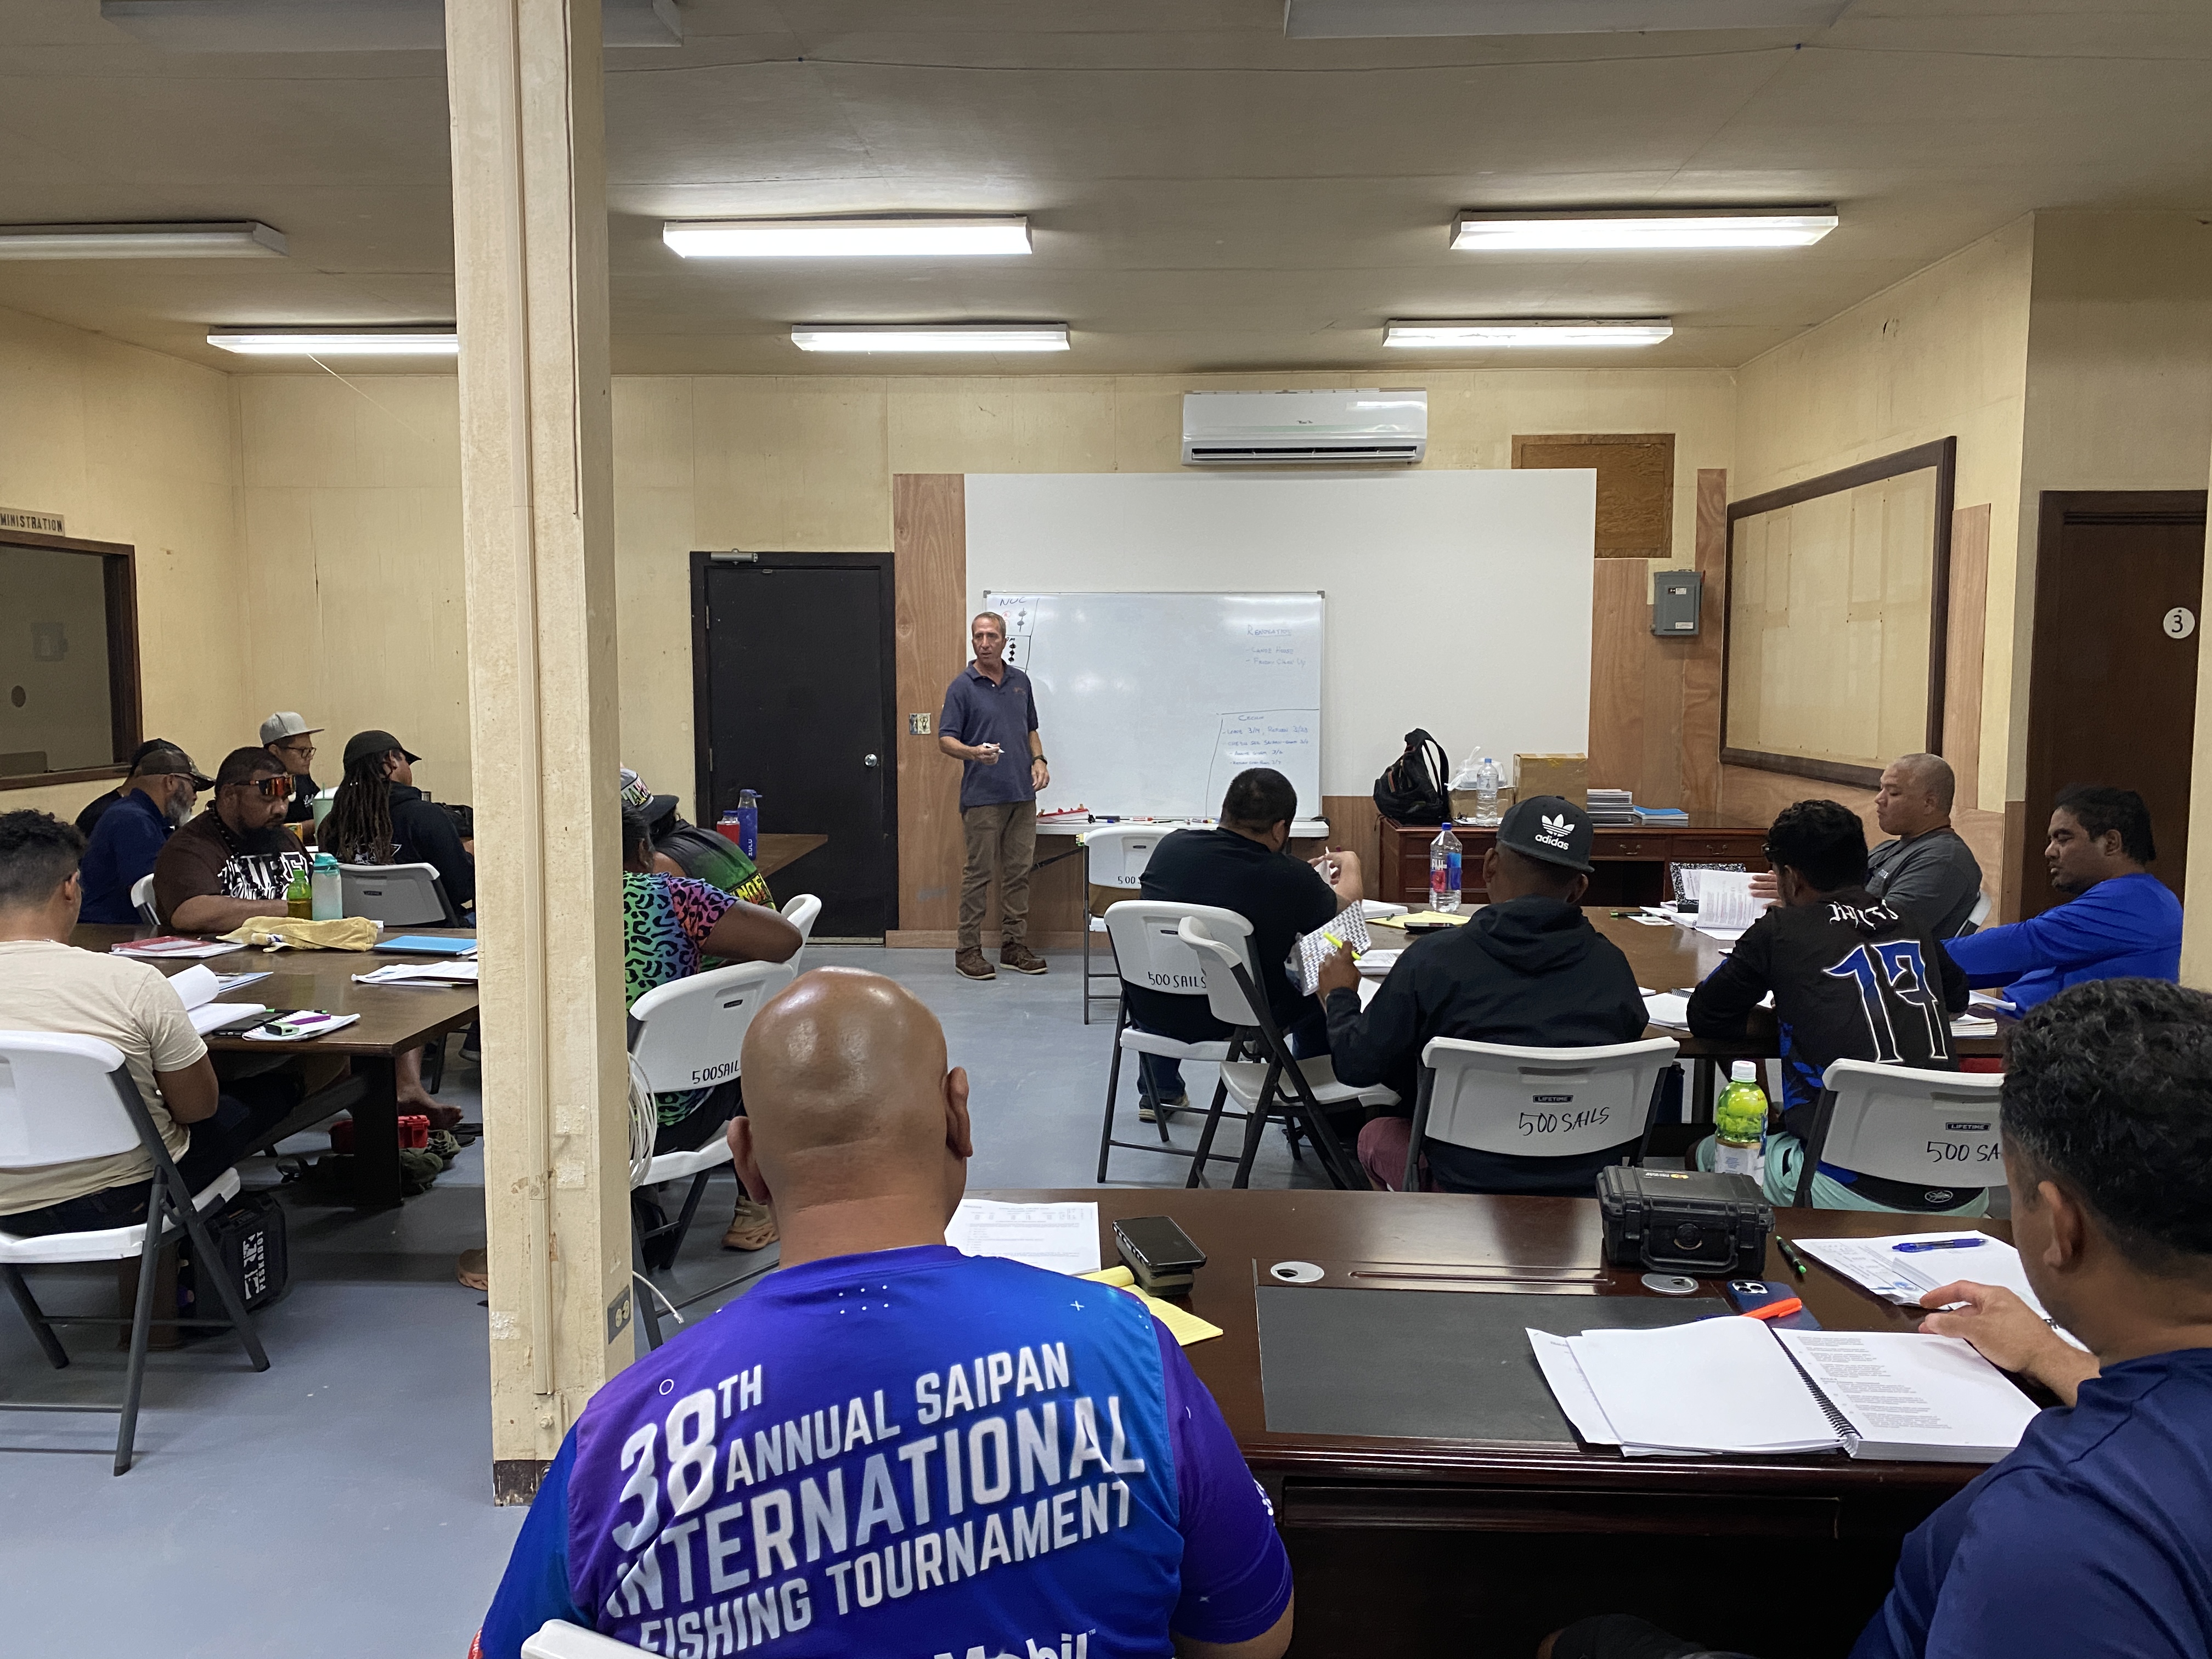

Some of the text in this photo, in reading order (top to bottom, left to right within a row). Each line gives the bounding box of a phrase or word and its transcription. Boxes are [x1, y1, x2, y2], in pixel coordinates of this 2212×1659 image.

[2171, 614, 2183, 633] 3
[1535, 834, 1570, 850] adidas
[1118, 876, 1136, 884] 500
[1148, 971, 1206, 989] 500 SAILS
[692, 1060, 741, 1085] 500SAIL
[1519, 1106, 1610, 1136] 500 SAILS
[1927, 1141, 1970, 1163] 500
[726, 1389, 900, 1492] ANNUAL
[916, 1342, 1070, 1425] SAIPAN
[606, 1396, 1146, 1618] INTERNATIONAL
[640, 1578, 812, 1659] FISHING
[825, 1480, 1130, 1615] TOURNAMENT
